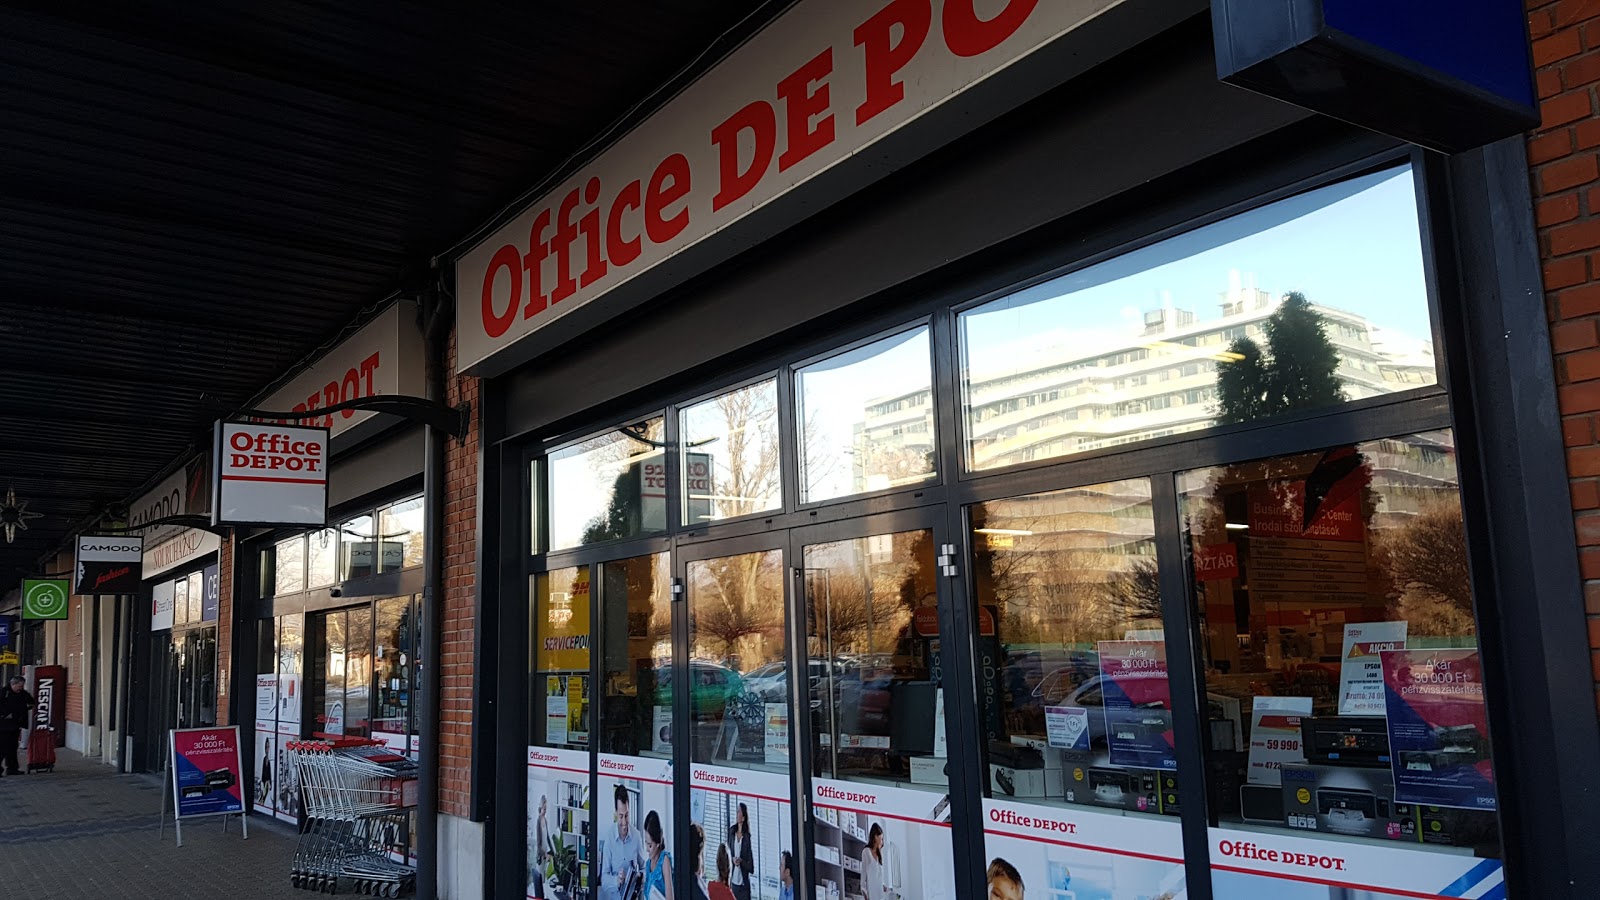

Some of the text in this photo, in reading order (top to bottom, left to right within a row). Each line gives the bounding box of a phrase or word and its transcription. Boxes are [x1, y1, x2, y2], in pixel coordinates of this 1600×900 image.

[481, 153, 691, 338] Office
[230, 432, 321, 456] Office
[1254, 519, 1283, 532] Irodai
[80, 544, 141, 552] CAMODO
[1129, 648, 1148, 658] Akár
[1121, 660, 1132, 669] 30
[1132, 660, 1148, 669] 000
[1425, 658, 1452, 670] Akár
[1414, 671, 1467, 683] 30 000 Ft
[1267, 739, 1279, 750] 59
[1280, 740, 1299, 751] 990
[530, 751, 544, 761] Office
[600, 759, 635, 772] Office DEPOT
[693, 769, 738, 786] Office DEPOT
[1284, 769, 1316, 780] EPSON
[817, 785, 876, 805] Office DEPOT
[990, 808, 1076, 834] Office DEPOT
[1219, 839, 1345, 871] Office DEPOT
